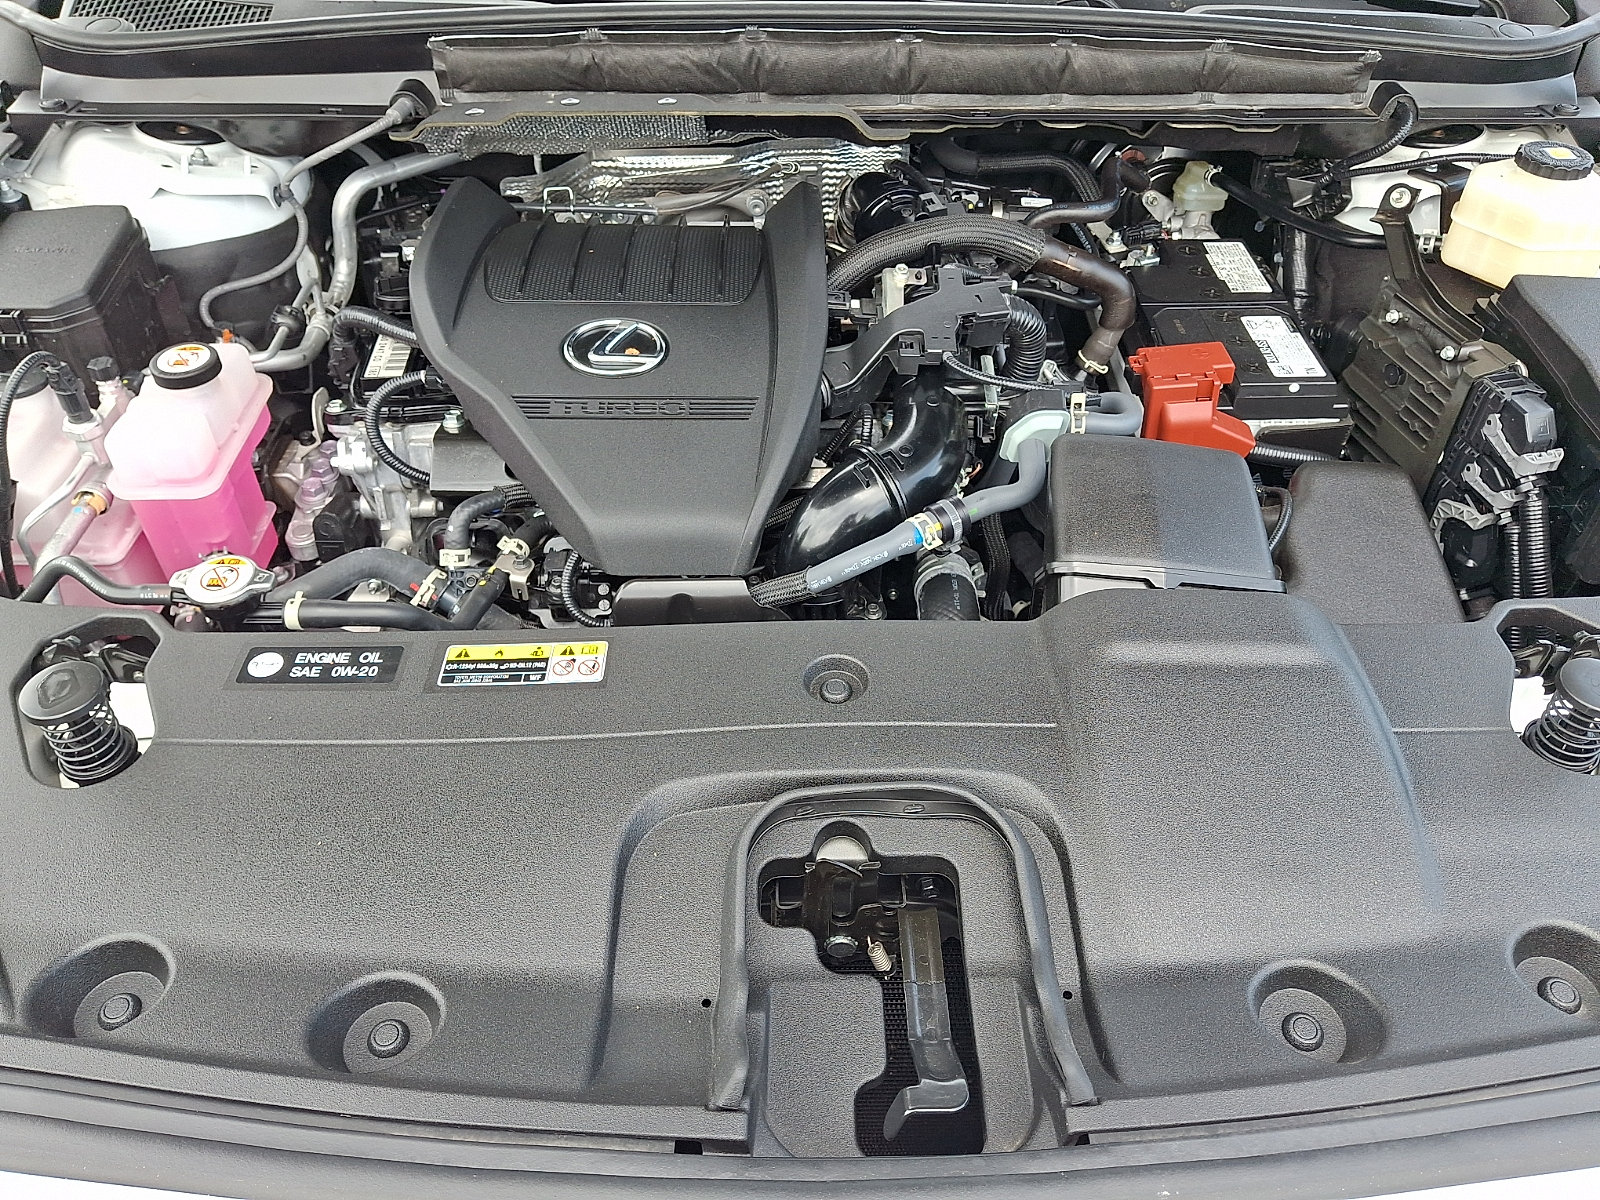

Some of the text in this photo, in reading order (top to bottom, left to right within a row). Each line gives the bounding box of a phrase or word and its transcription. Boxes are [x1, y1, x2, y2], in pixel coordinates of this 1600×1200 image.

[554, 400, 687, 415] TURBO
[294, 652, 384, 664] ENGINE OIL
[289, 665, 379, 678] SAE 0W-20
